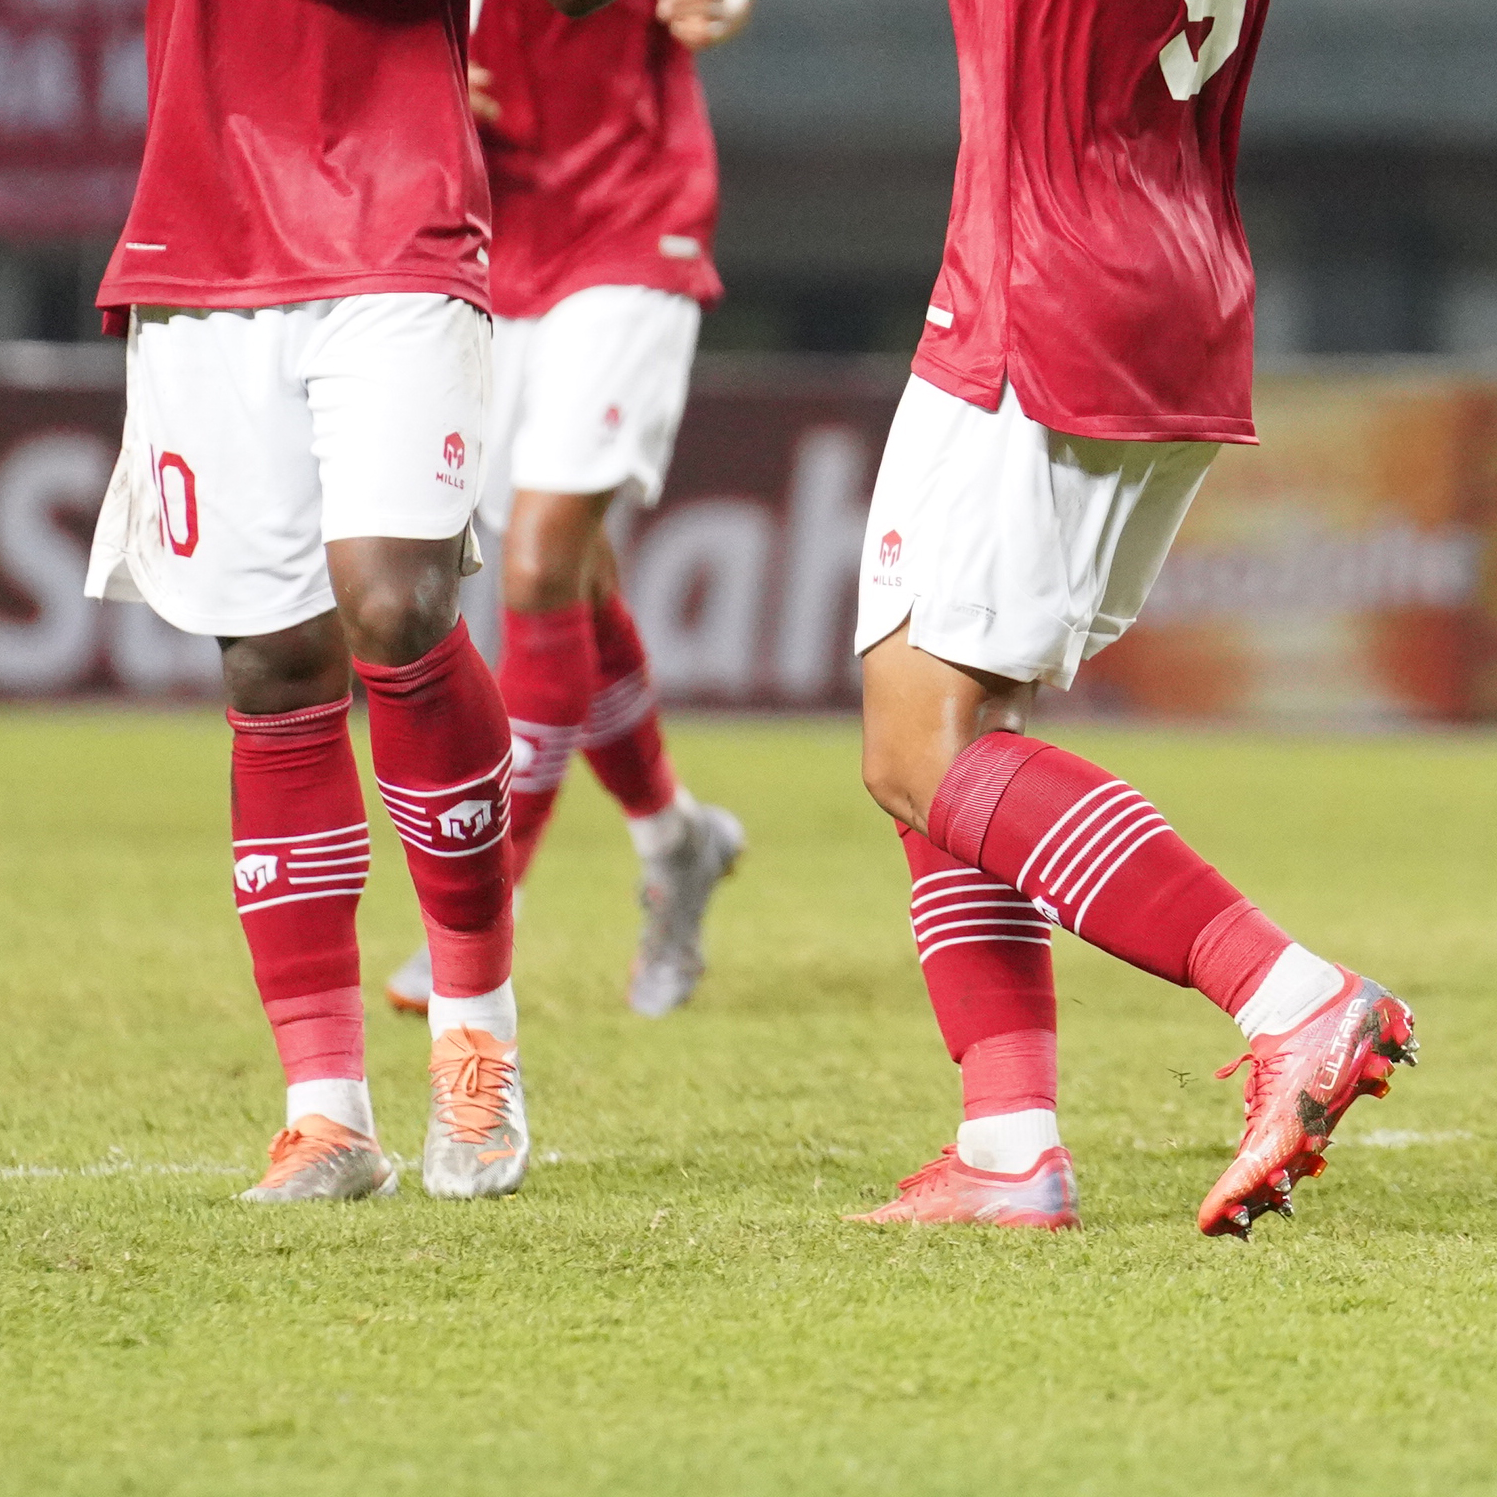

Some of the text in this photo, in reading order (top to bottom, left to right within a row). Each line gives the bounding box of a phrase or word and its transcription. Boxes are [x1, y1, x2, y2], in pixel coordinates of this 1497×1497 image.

[435, 471, 465, 491] MILLS
[873, 575, 902, 587] MILLS
[1319, 998, 1367, 1090] ULTRA
